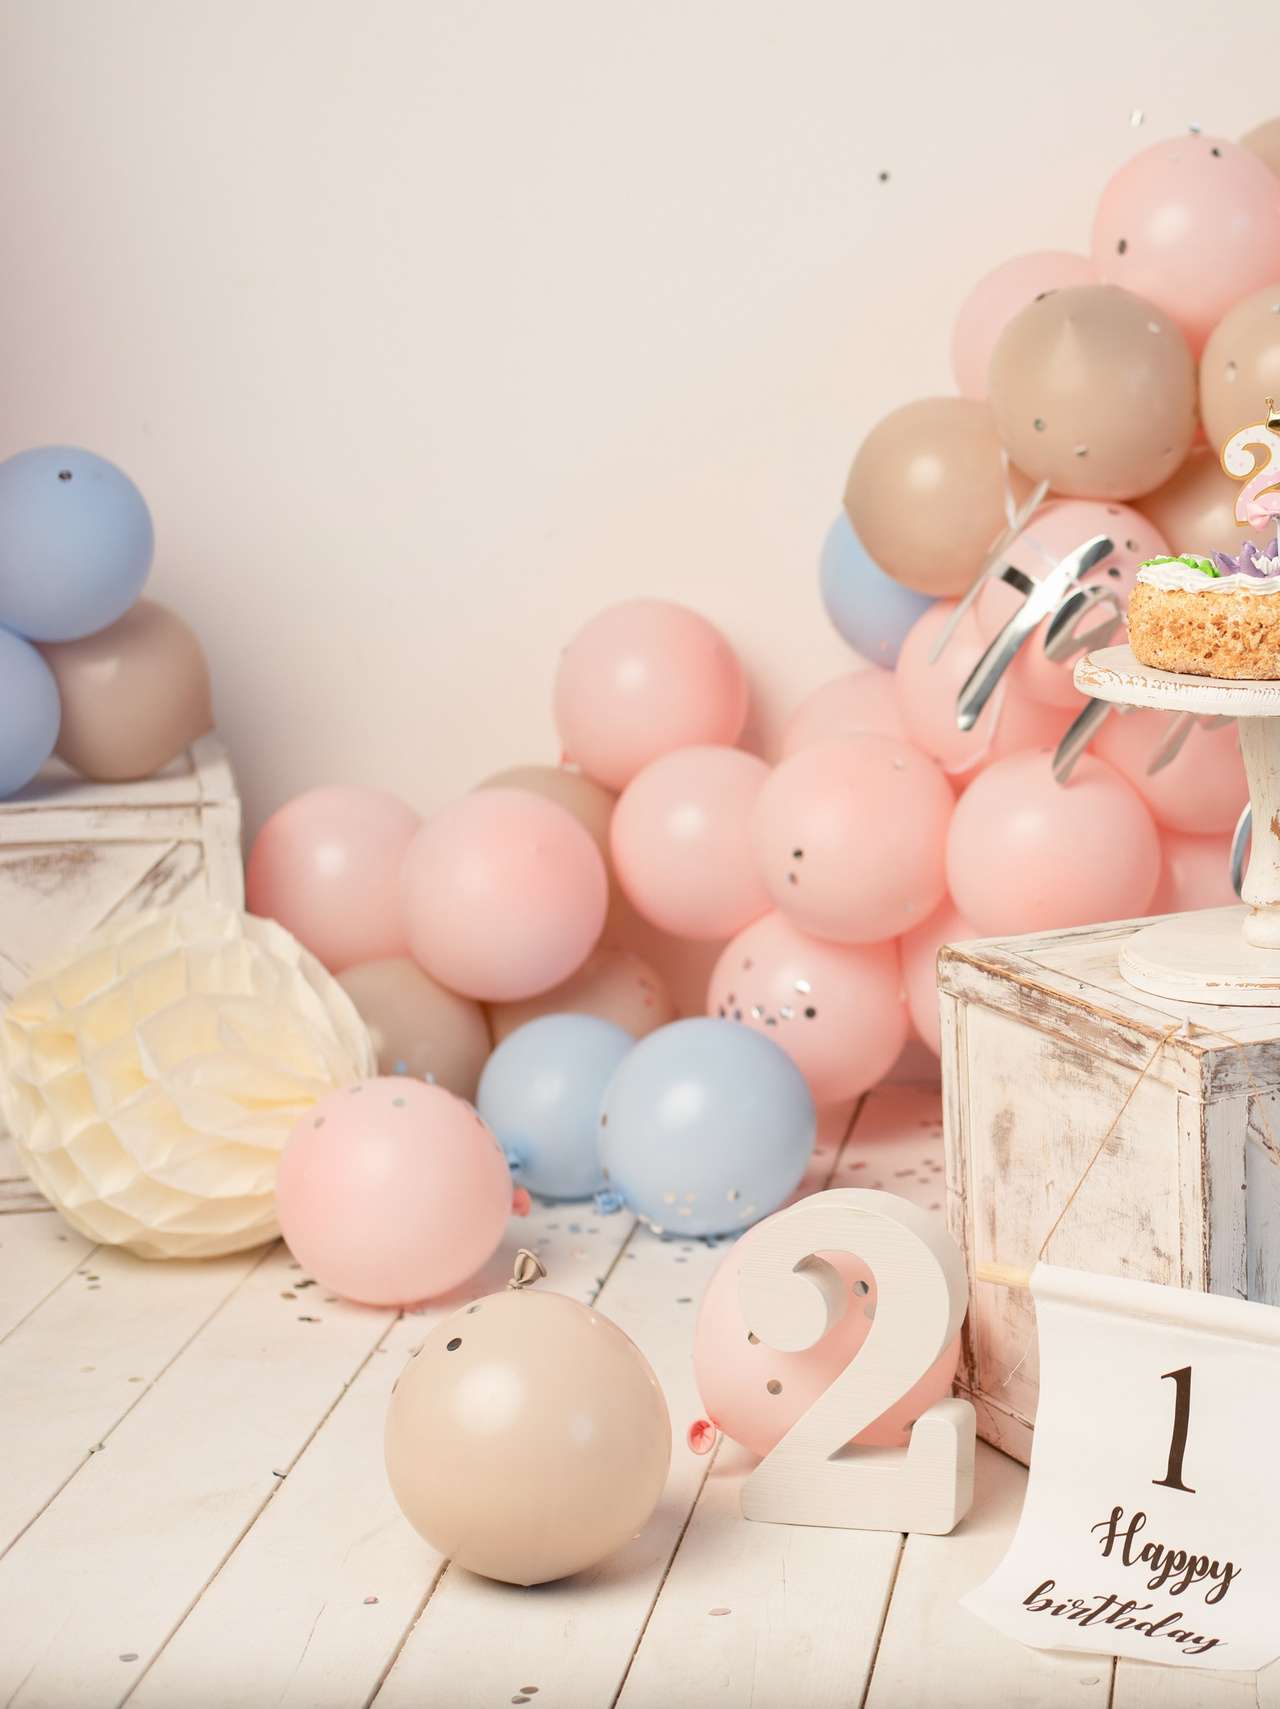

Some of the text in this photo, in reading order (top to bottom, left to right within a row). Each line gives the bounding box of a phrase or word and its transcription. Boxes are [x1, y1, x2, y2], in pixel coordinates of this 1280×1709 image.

[737, 1187, 977, 1536] 2
[1151, 1365, 1196, 1495] 1
[1090, 1505, 1242, 1606] Happy
[1022, 1579, 1229, 1656] birthday
